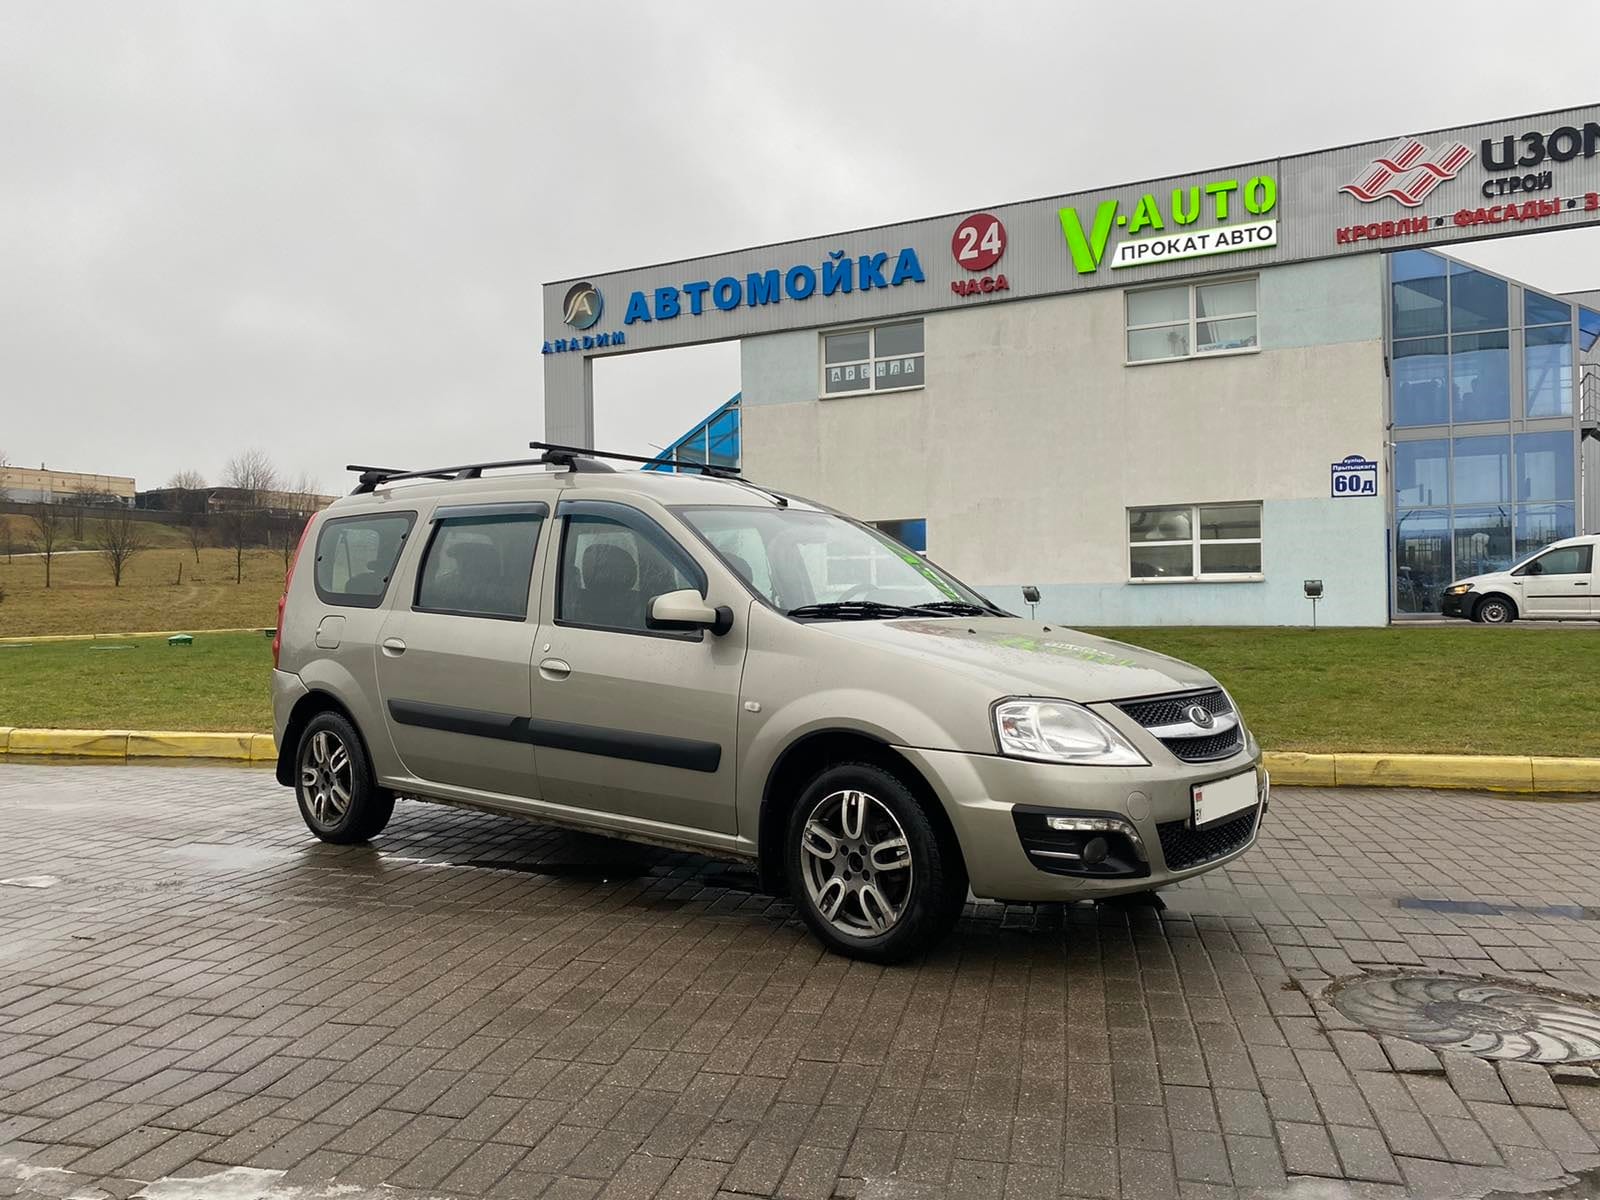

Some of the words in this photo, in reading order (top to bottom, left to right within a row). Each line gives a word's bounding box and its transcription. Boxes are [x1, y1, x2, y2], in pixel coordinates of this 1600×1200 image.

[1482, 170, 1552, 199] СТРОЙ
[1336, 216, 1428, 244] КРОВЛИ
[1453, 197, 1561, 228] ФАСАДЫ
[958, 221, 1002, 261] 24
[1120, 234, 1210, 261] ПРОКАТ
[1215, 225, 1273, 248] АВТО
[623, 247, 926, 325] АВТОМОЙКА
[951, 274, 1010, 297] ЧАСА
[832, 361, 914, 381] АРЕНДА
